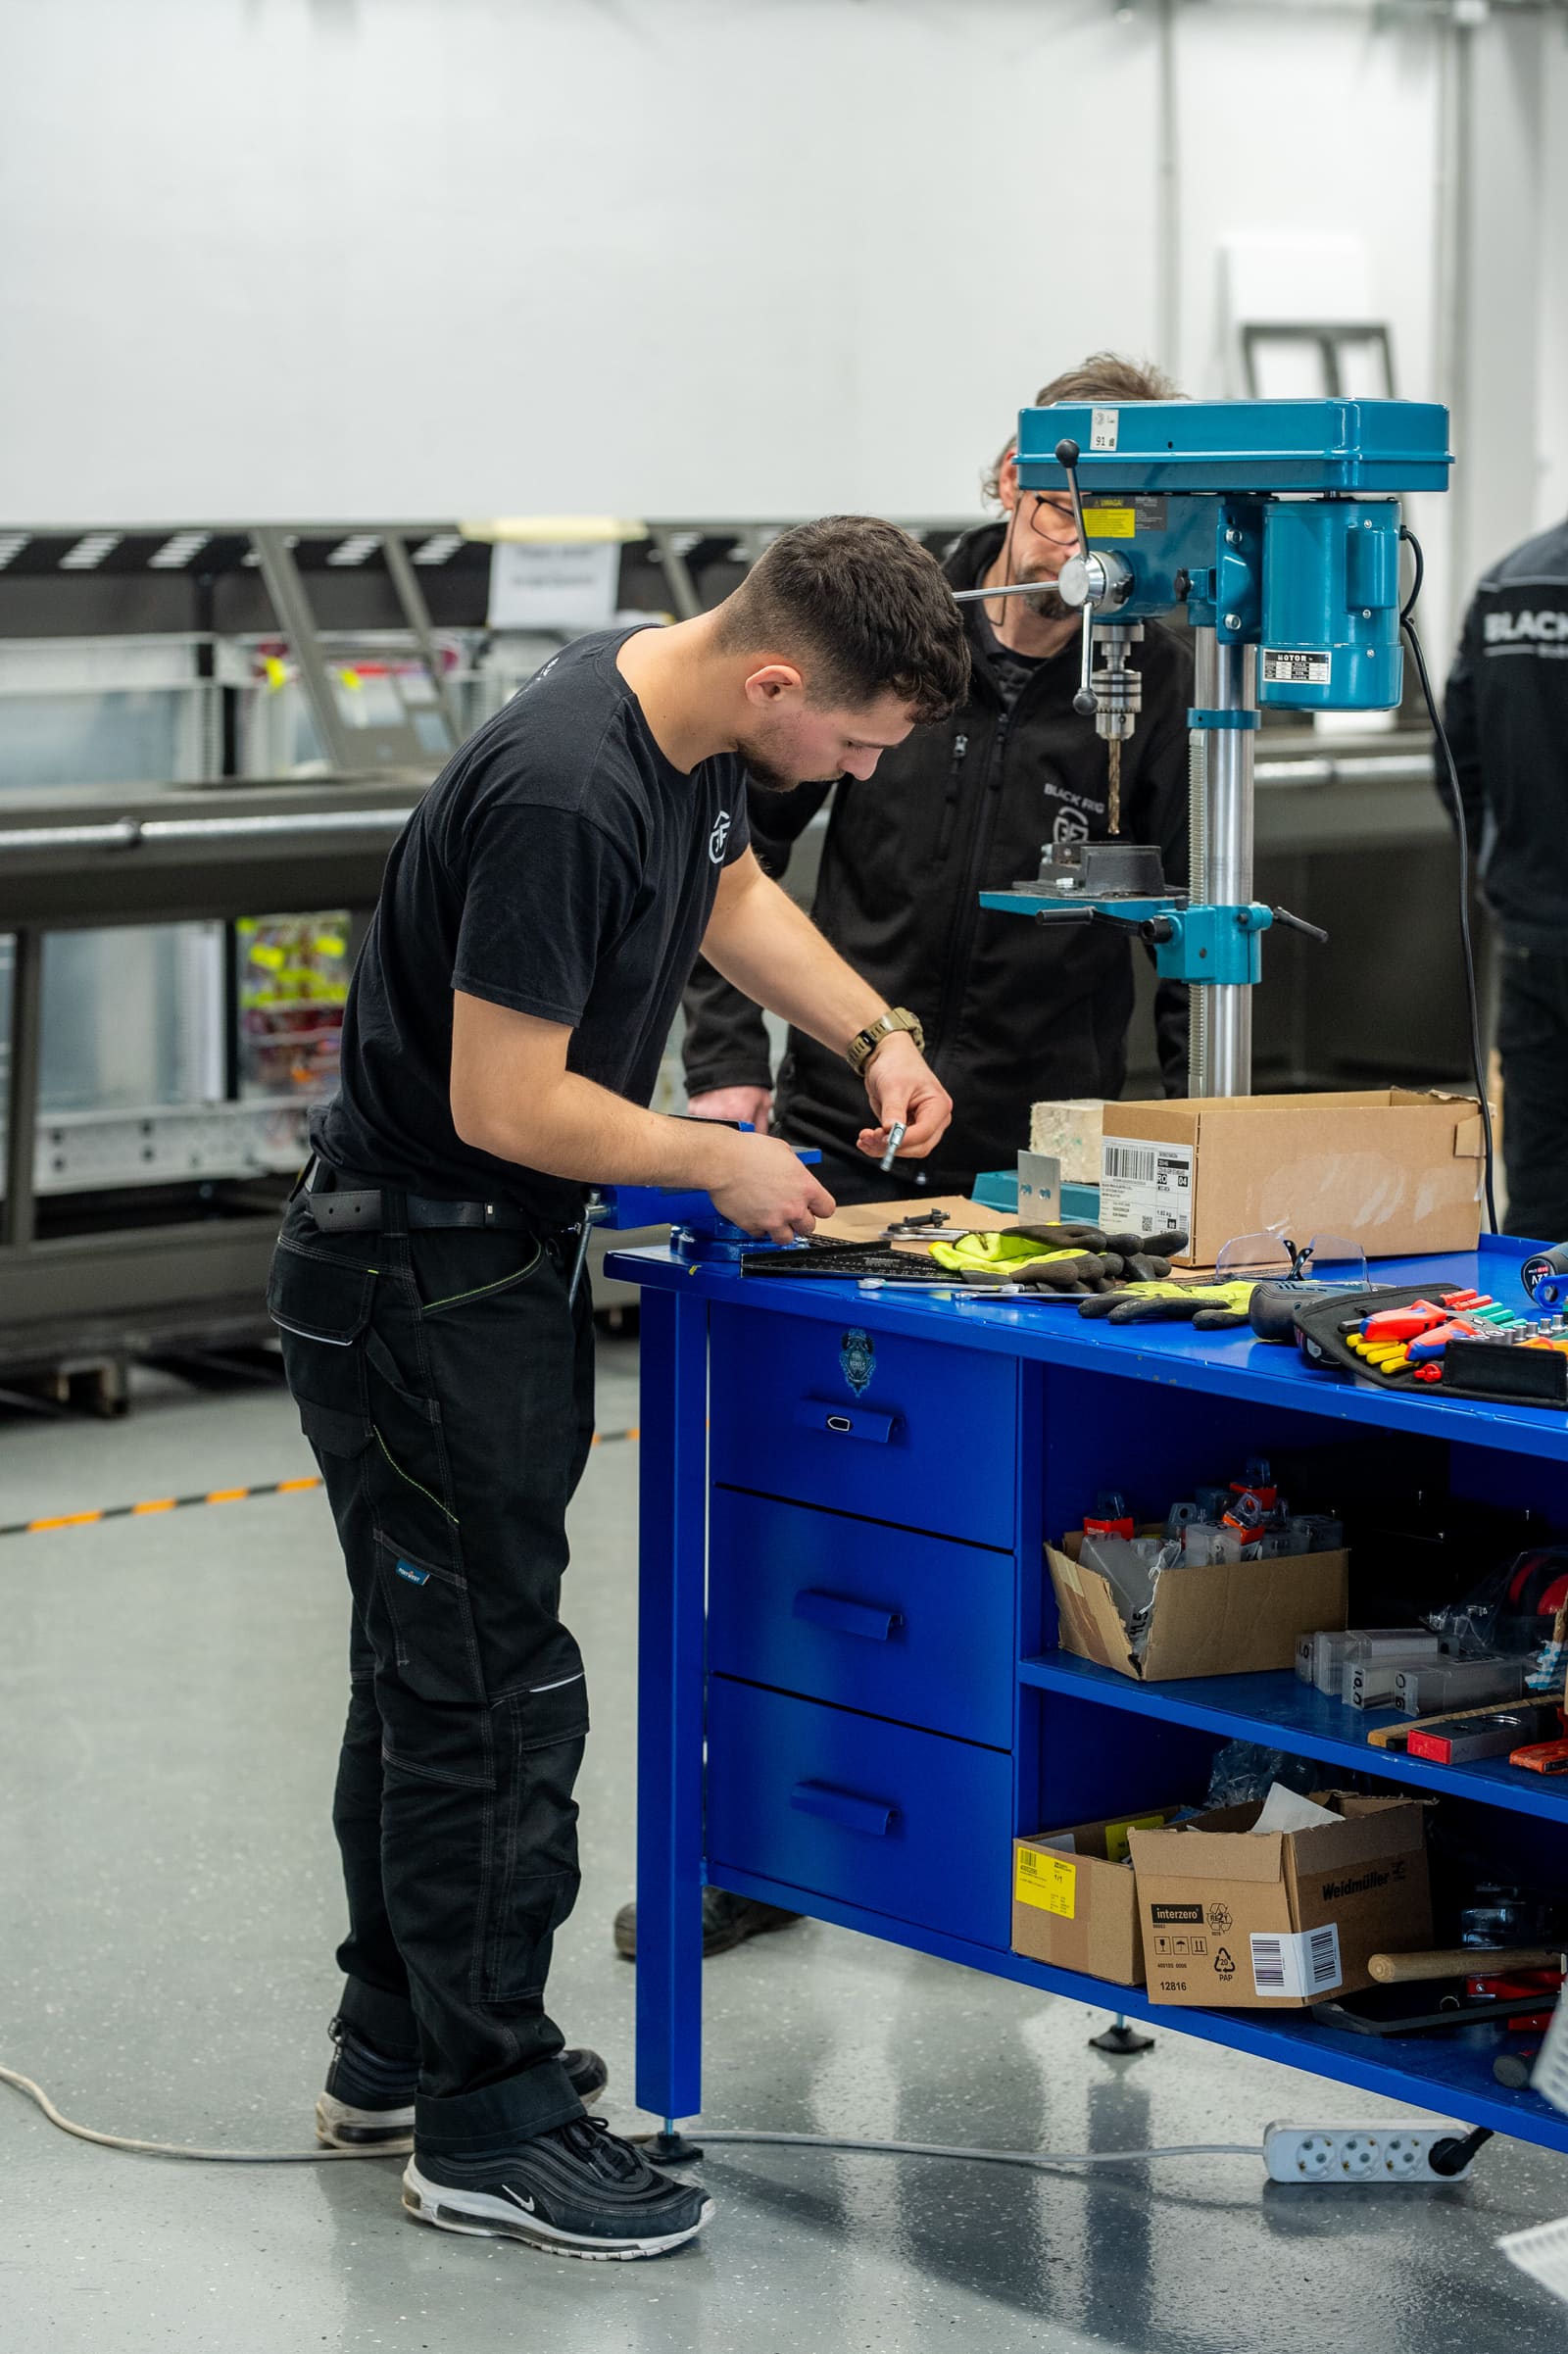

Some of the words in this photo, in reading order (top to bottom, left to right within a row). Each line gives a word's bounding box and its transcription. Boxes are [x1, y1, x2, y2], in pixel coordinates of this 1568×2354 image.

[1322, 1870, 1390, 1901] Weidmüller
[1156, 1907, 1198, 1920] interzero
[1160, 1982, 1187, 1991] 12816
